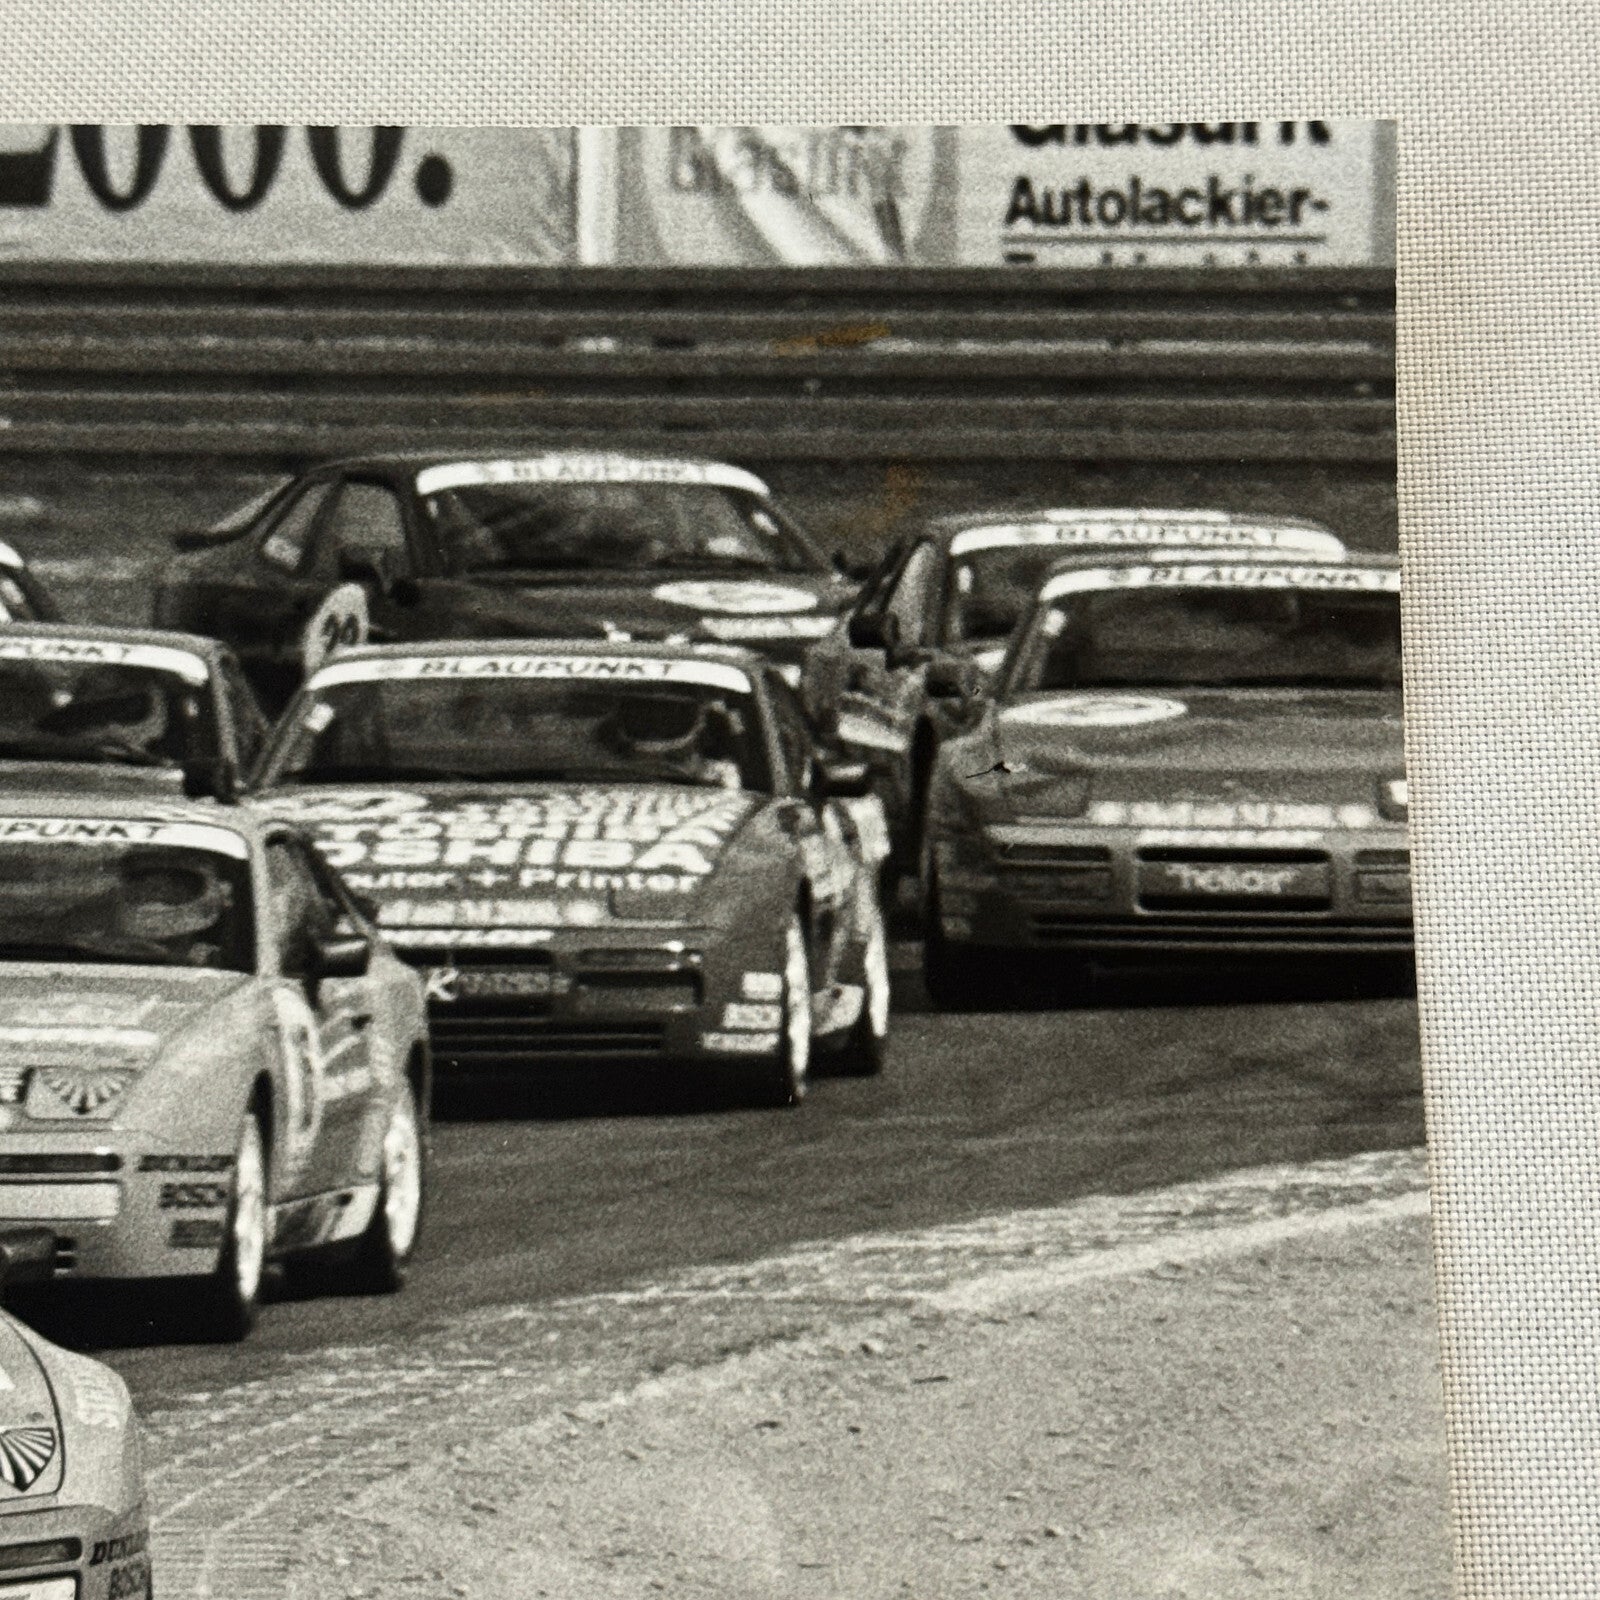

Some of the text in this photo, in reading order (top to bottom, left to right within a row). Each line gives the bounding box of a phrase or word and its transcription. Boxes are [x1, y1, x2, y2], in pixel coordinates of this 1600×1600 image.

[1004, 175, 1329, 227] Autolackier-
[1055, 526, 1279, 545] BLAUPUNKT
[1149, 567, 1391, 588] BLAUPUNKT
[420, 660, 674, 677] BLAUPUNKT
[518, 868, 700, 893] Printer
